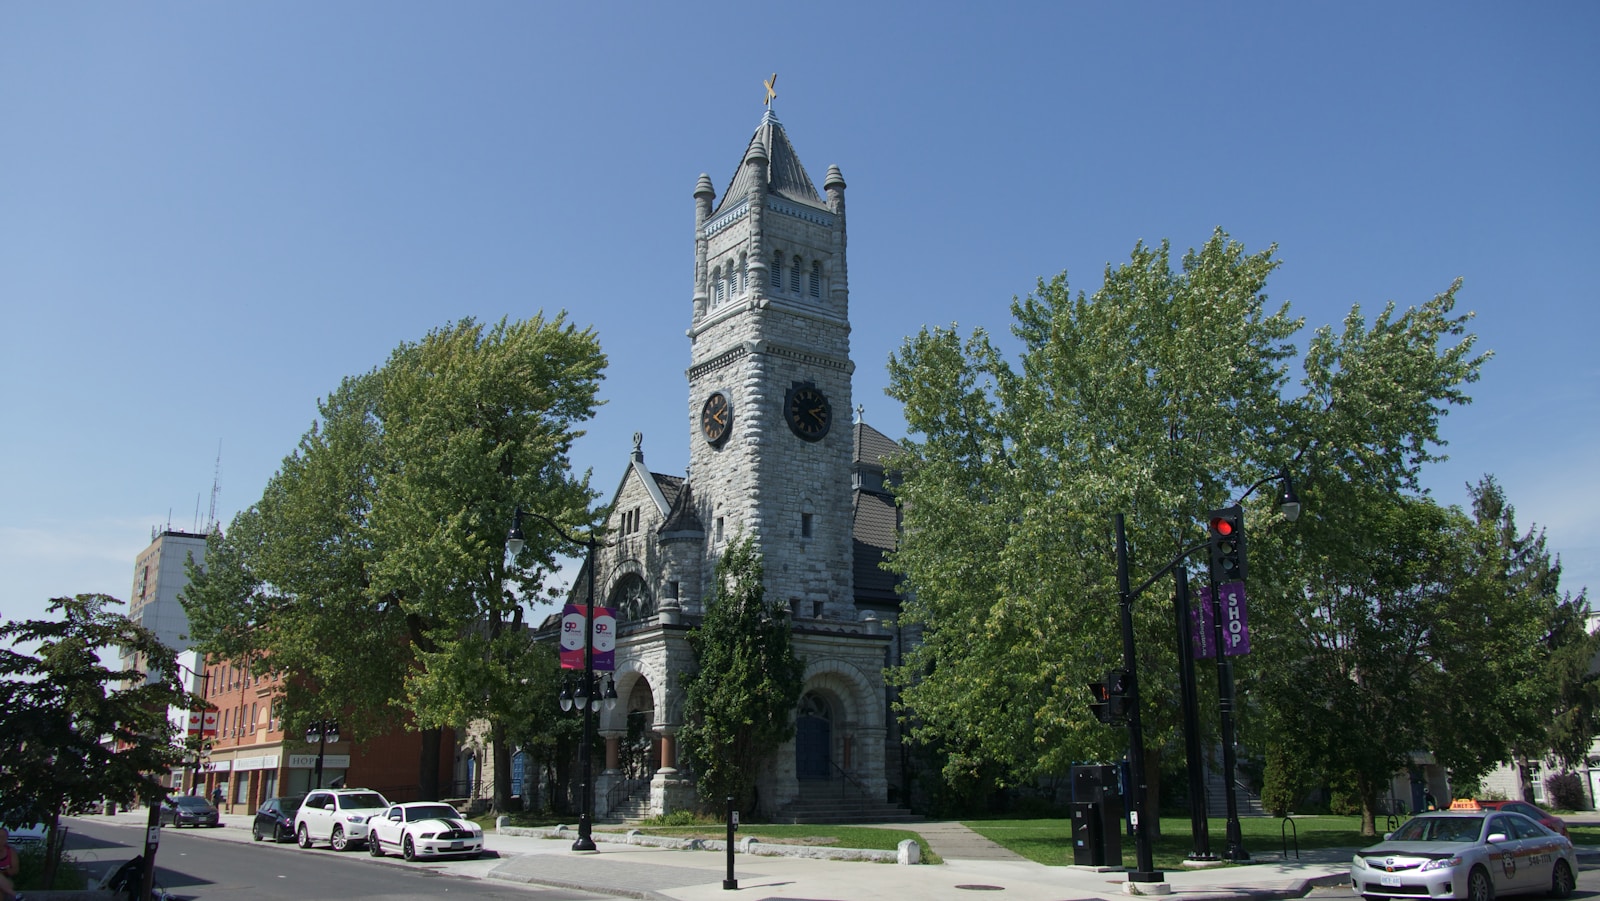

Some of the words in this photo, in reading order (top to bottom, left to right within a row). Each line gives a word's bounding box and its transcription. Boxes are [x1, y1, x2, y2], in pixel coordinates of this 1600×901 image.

[1228, 593, 1242, 648] SHOP
[564, 621, 577, 633] go
[595, 623, 608, 634] go
